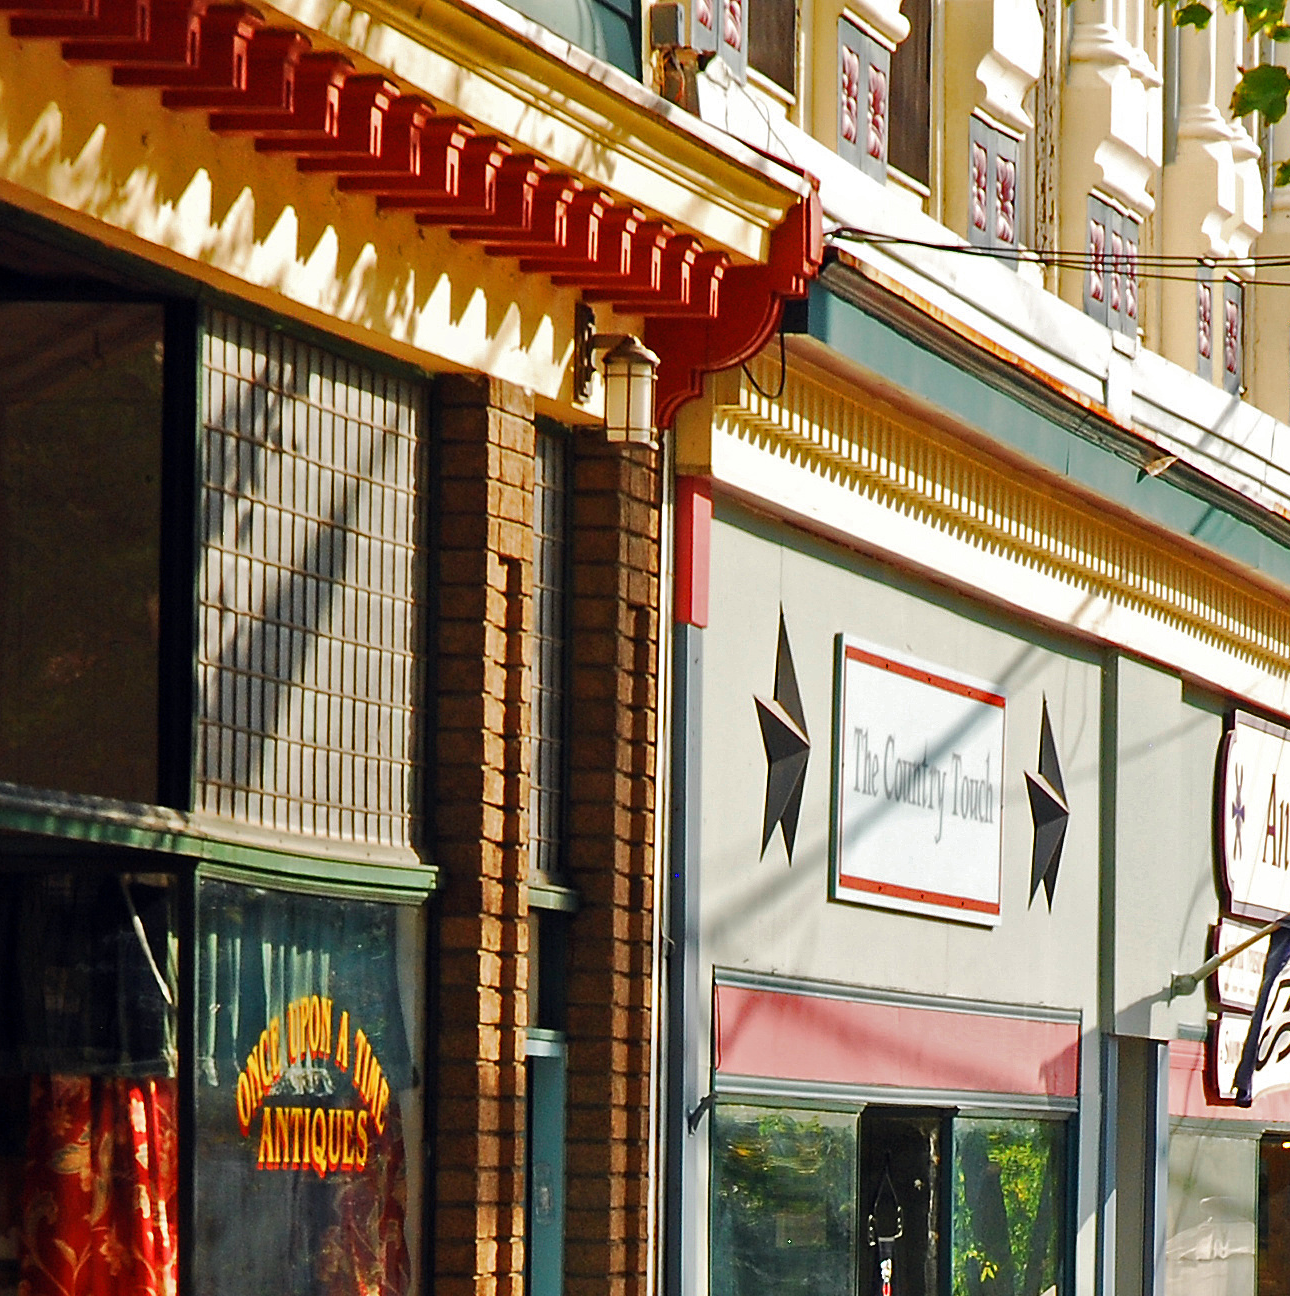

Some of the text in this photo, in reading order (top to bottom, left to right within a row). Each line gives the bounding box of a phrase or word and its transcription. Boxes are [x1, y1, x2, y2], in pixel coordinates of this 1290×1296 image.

[854, 727, 993, 844] The Country Touch
[237, 995, 390, 1136] ONCE UPON A TIME
[257, 1107, 369, 1178] ANTIQUES
